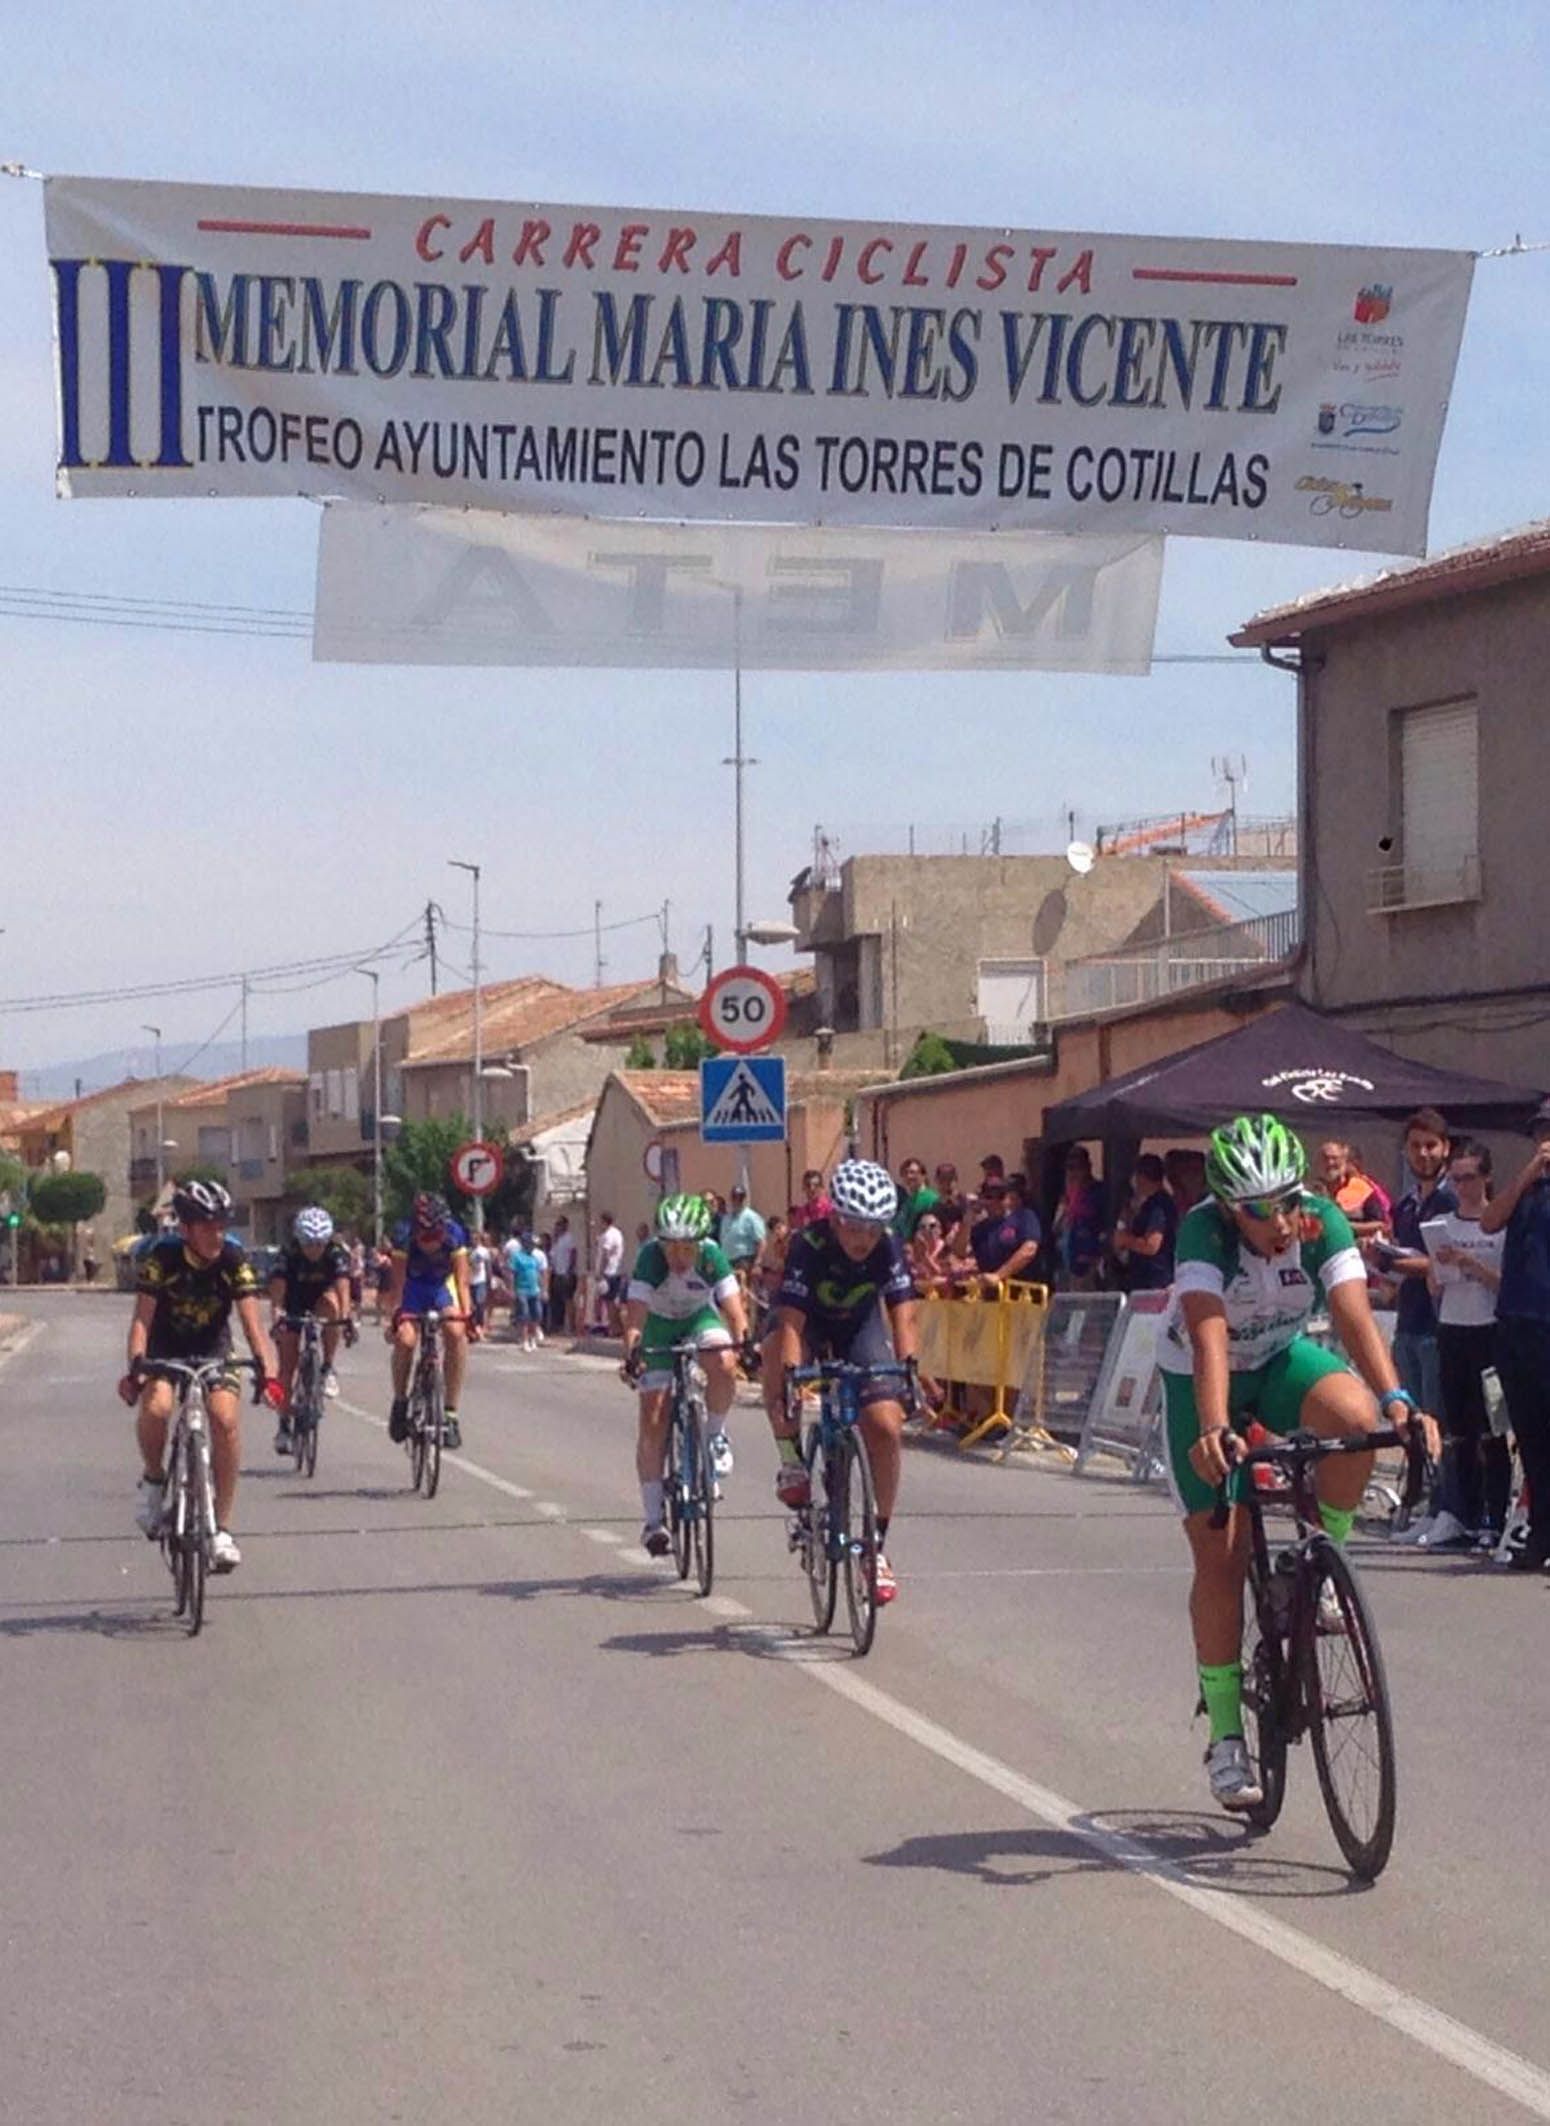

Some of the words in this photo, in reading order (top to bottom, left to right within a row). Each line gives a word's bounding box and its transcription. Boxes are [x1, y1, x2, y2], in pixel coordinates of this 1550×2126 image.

[415, 213, 743, 277] CARRERA
[775, 233, 1094, 294] CICLISTA
[49, 258, 194, 468] III
[194, 271, 576, 385] MEMORIAL
[587, 291, 815, 396] MARIA
[826, 302, 982, 402] INES
[999, 310, 1288, 415] VICENTE
[198, 405, 363, 470] TROFEO
[374, 420, 706, 487] AYUNTAMIENTO
[719, 433, 800, 490] LAS
[815, 436, 984, 497] TORRES
[998, 443, 1054, 500] DE
[1066, 445, 1271, 508] COTILLAS
[721, 995, 765, 1023] 50
